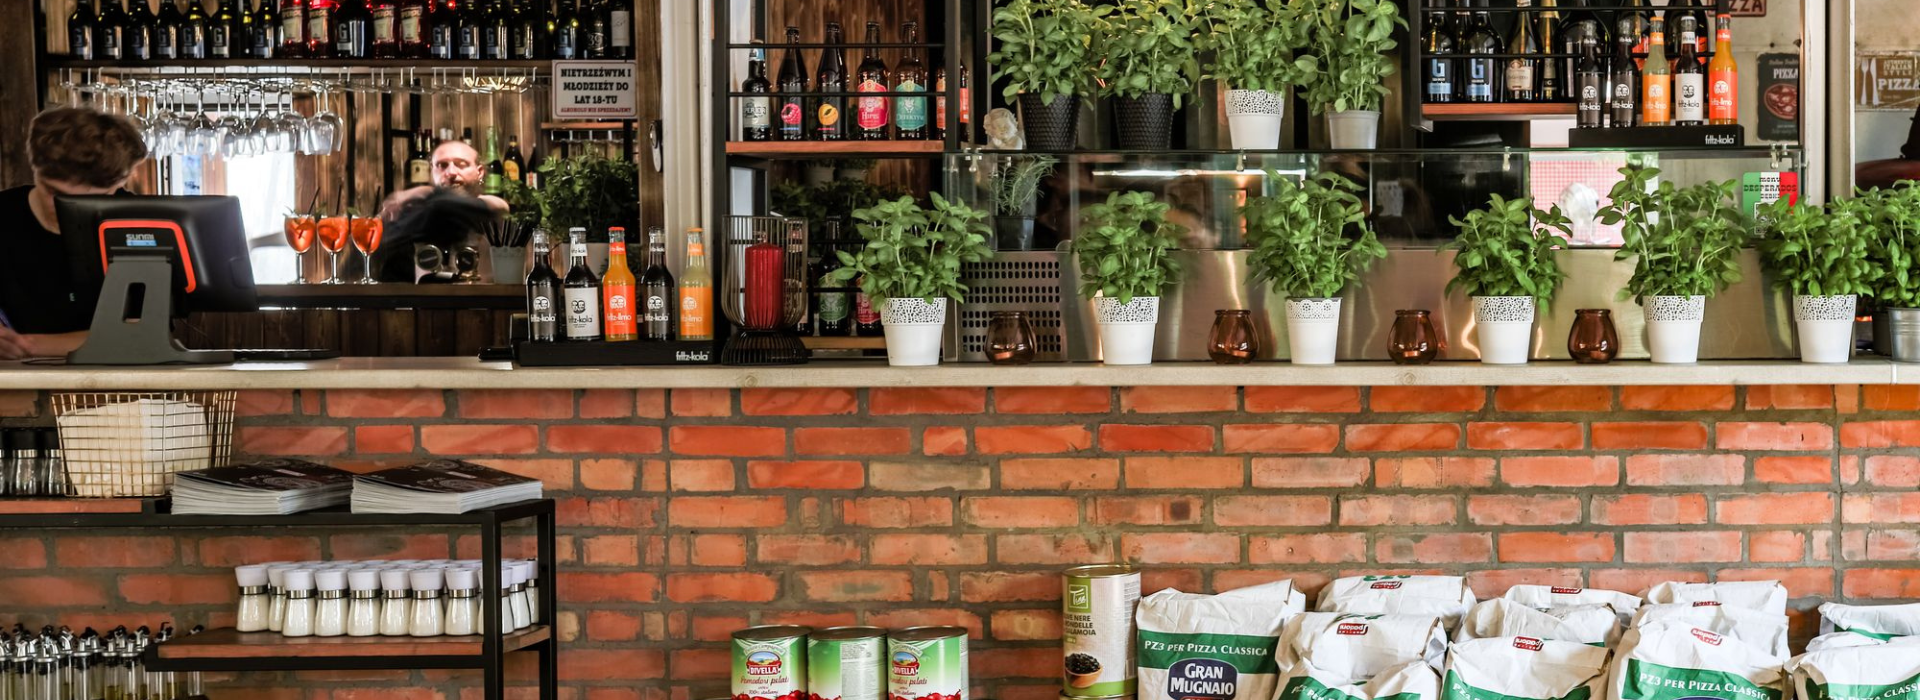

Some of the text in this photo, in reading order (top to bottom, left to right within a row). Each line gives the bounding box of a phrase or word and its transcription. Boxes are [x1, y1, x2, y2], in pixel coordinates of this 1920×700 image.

[213, 27, 223, 44] G
[338, 23, 348, 40] G
[560, 66, 632, 77] NIETRZEŹWYM I
[616, 82, 629, 91] DO
[1878, 78, 1920, 91] PIZZA
[574, 95, 618, 104] LAT 18-TU
[1704, 134, 1735, 145] fritz-kola
[1743, 184, 1797, 192] DESPERADOS
[675, 350, 709, 361] fritz-kola
[1074, 614, 1091, 622] NERE
[1144, 640, 1165, 651] PZ3
[1187, 643, 1218, 654] PIZZA
[1220, 645, 1268, 657] CLASSICA
[1184, 662, 1224, 680] GRAN
[1170, 677, 1234, 695] MUGNAIO
[1640, 673, 1662, 686] PZ3
[1664, 678, 1686, 690] PER
[1688, 681, 1721, 691] PIZZA
